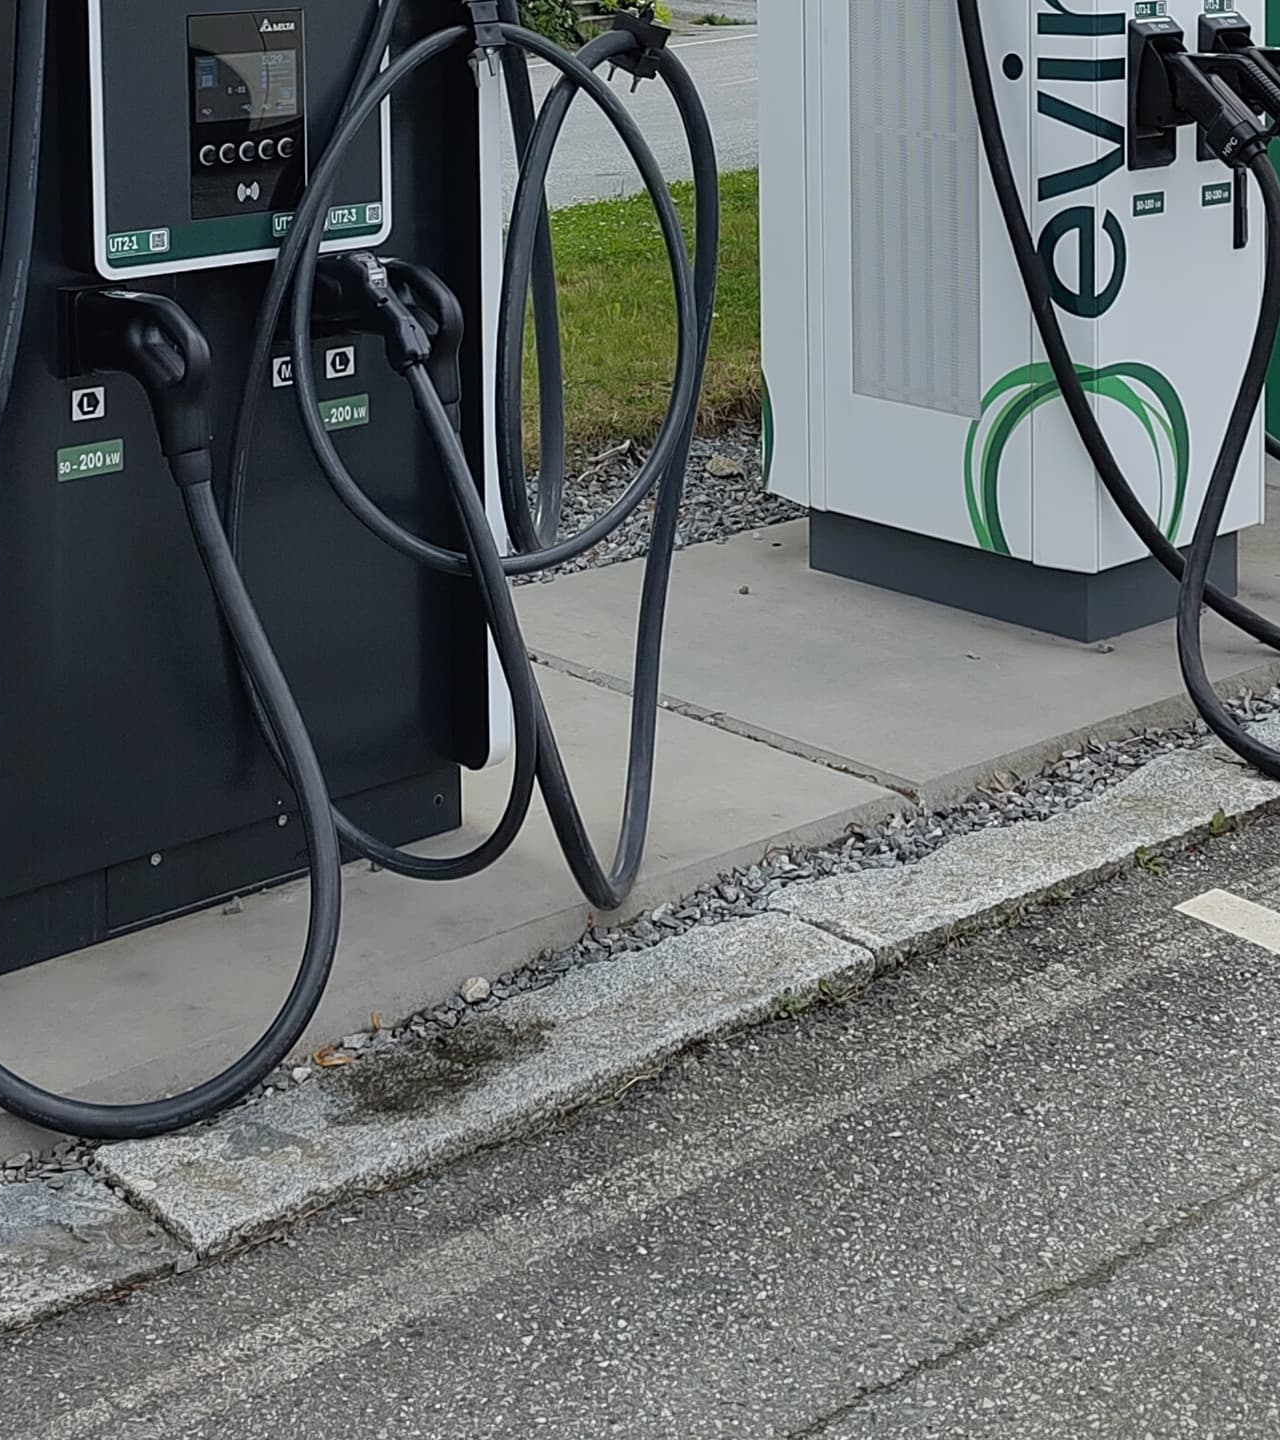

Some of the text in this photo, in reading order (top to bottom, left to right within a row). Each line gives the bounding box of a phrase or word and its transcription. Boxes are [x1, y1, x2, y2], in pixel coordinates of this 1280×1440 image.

[330, 208, 357, 224] UT2-3
[109, 235, 139, 252] UT2-1
[335, 355, 345, 370] L
[83, 396, 95, 412] L
[353, 406, 367, 419] kW
[105, 452, 121, 466] kW
